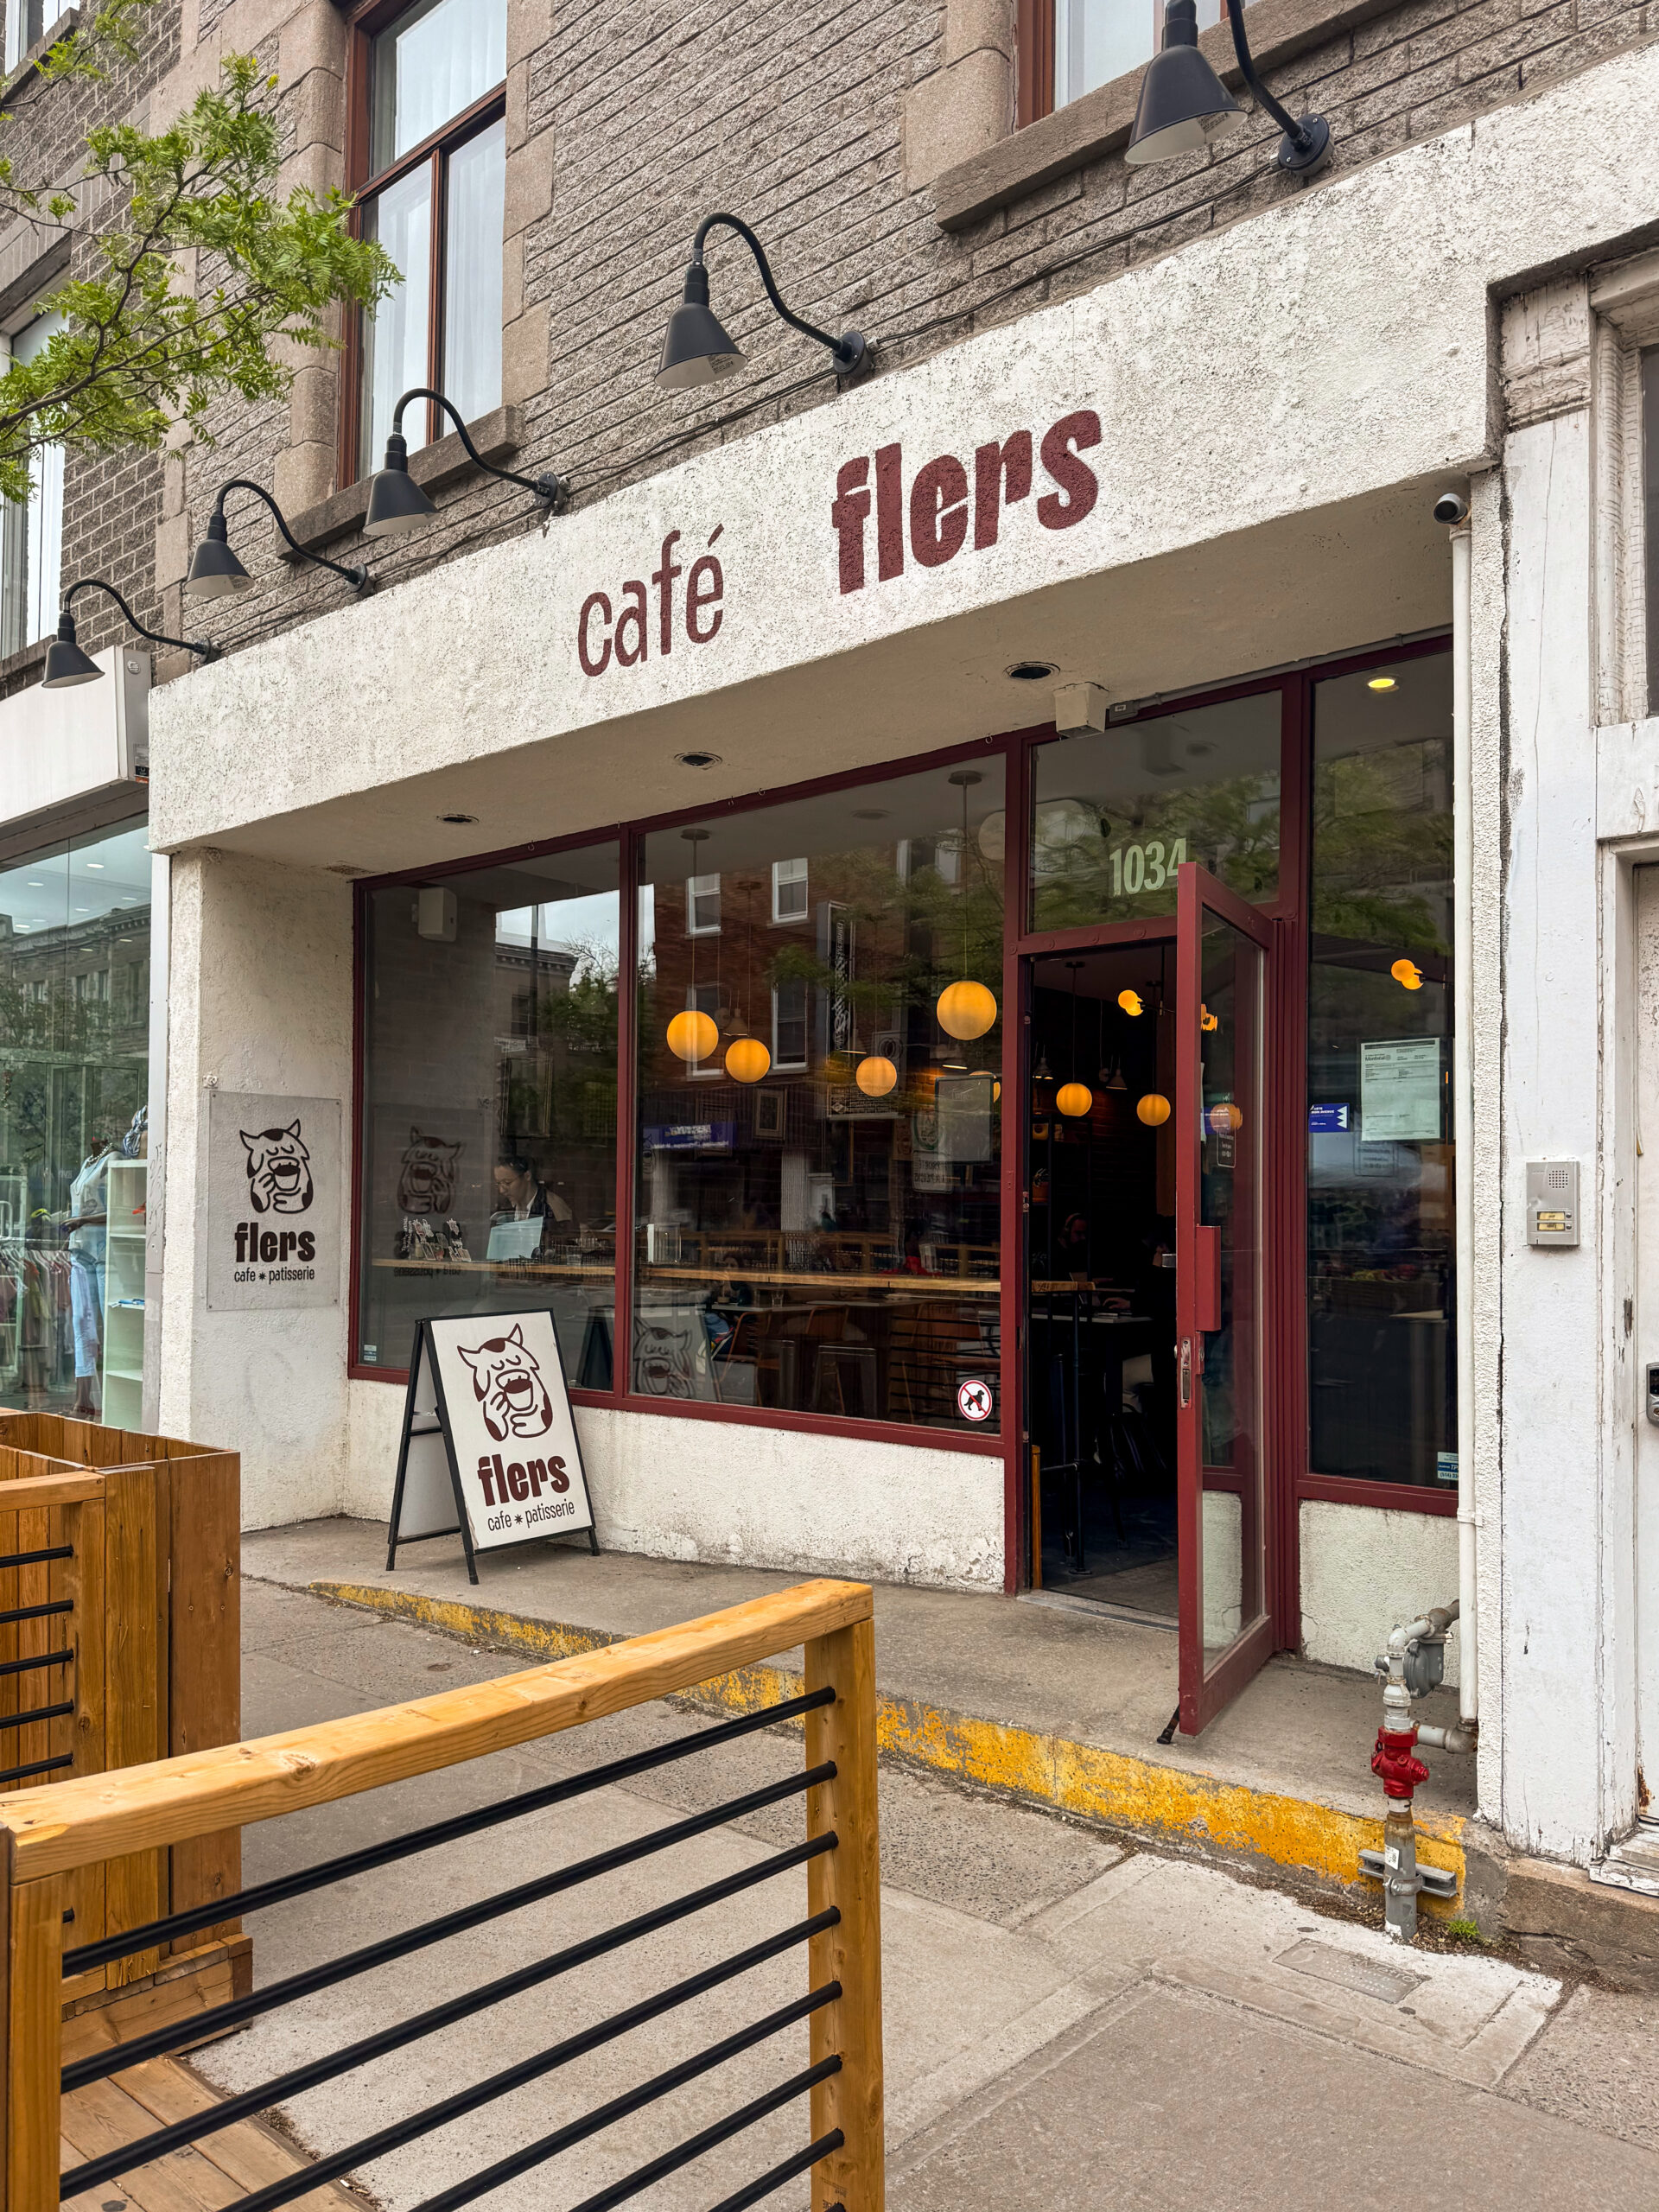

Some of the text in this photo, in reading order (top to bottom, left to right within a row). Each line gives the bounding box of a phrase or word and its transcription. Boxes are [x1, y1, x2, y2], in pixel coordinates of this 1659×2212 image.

[578, 410, 1103, 677] café flers
[1109, 837, 1187, 897] 1034
[234, 1222, 316, 1262] flers
[234, 1266, 315, 1285] cafe patisserie
[477, 1454, 570, 1507] flers
[487, 1498, 575, 1531] cafe patisserie
